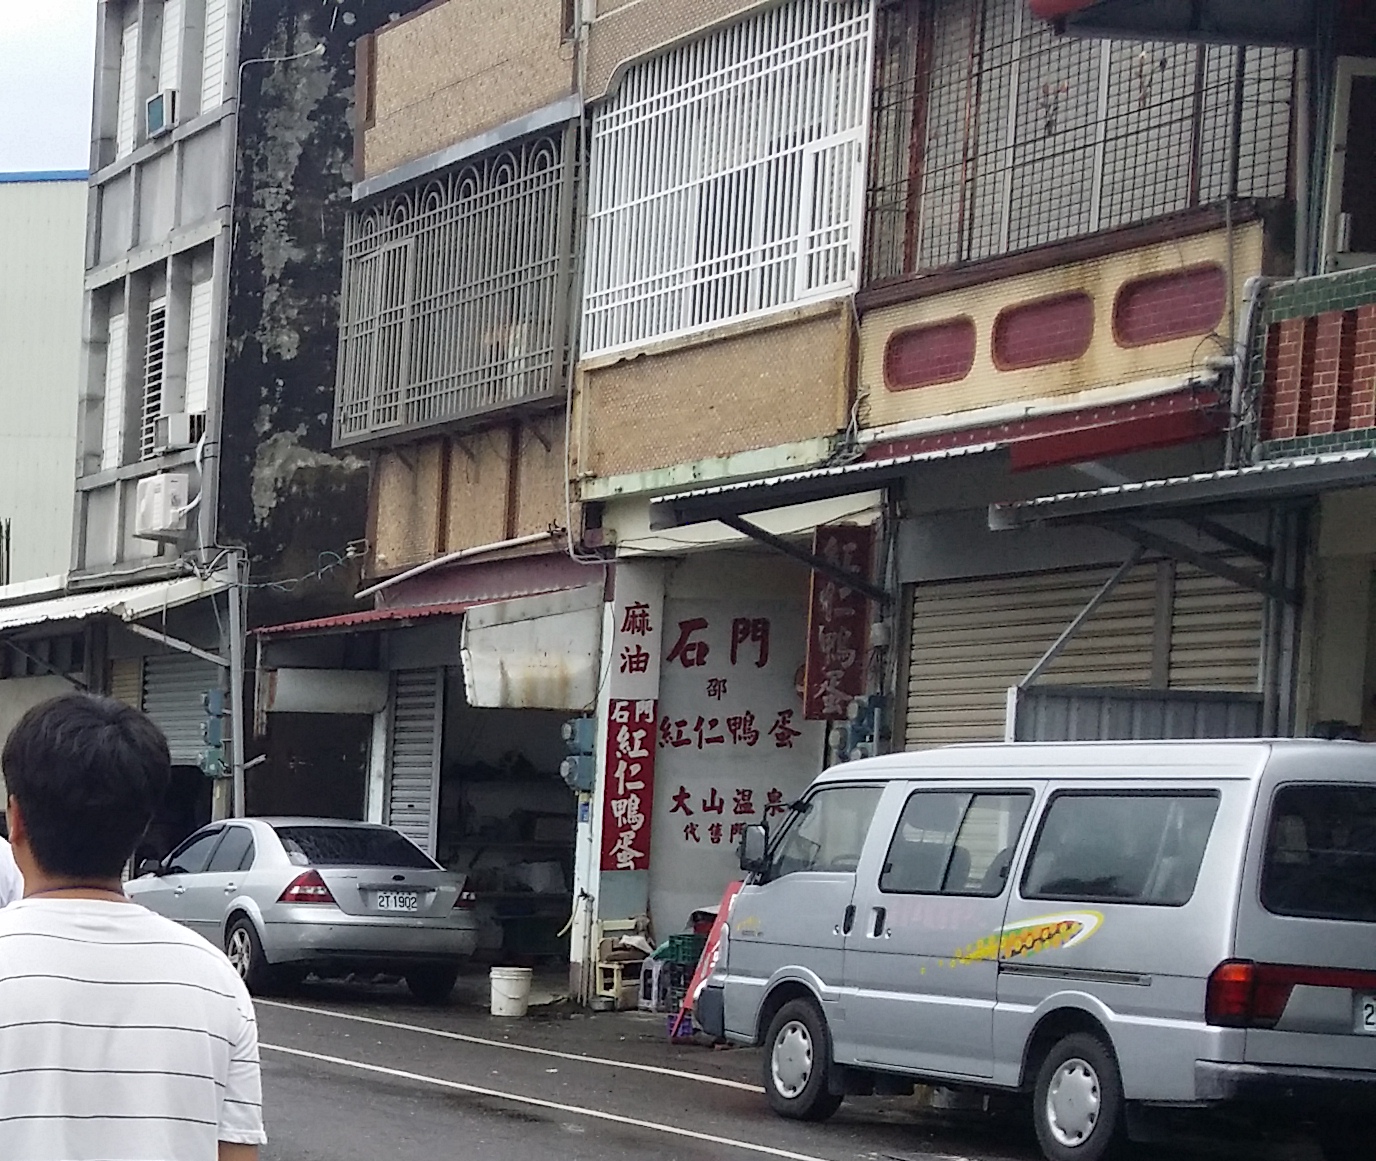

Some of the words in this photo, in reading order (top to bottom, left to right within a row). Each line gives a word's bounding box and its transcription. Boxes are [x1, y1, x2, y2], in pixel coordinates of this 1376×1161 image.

[620, 600, 653, 674] 麻油
[666, 616, 771, 669] 石門
[610, 699, 655, 723] 石門
[658, 708, 802, 750] 紅仁鴨蛋
[609, 724, 650, 871] 紅仁鴨蛋
